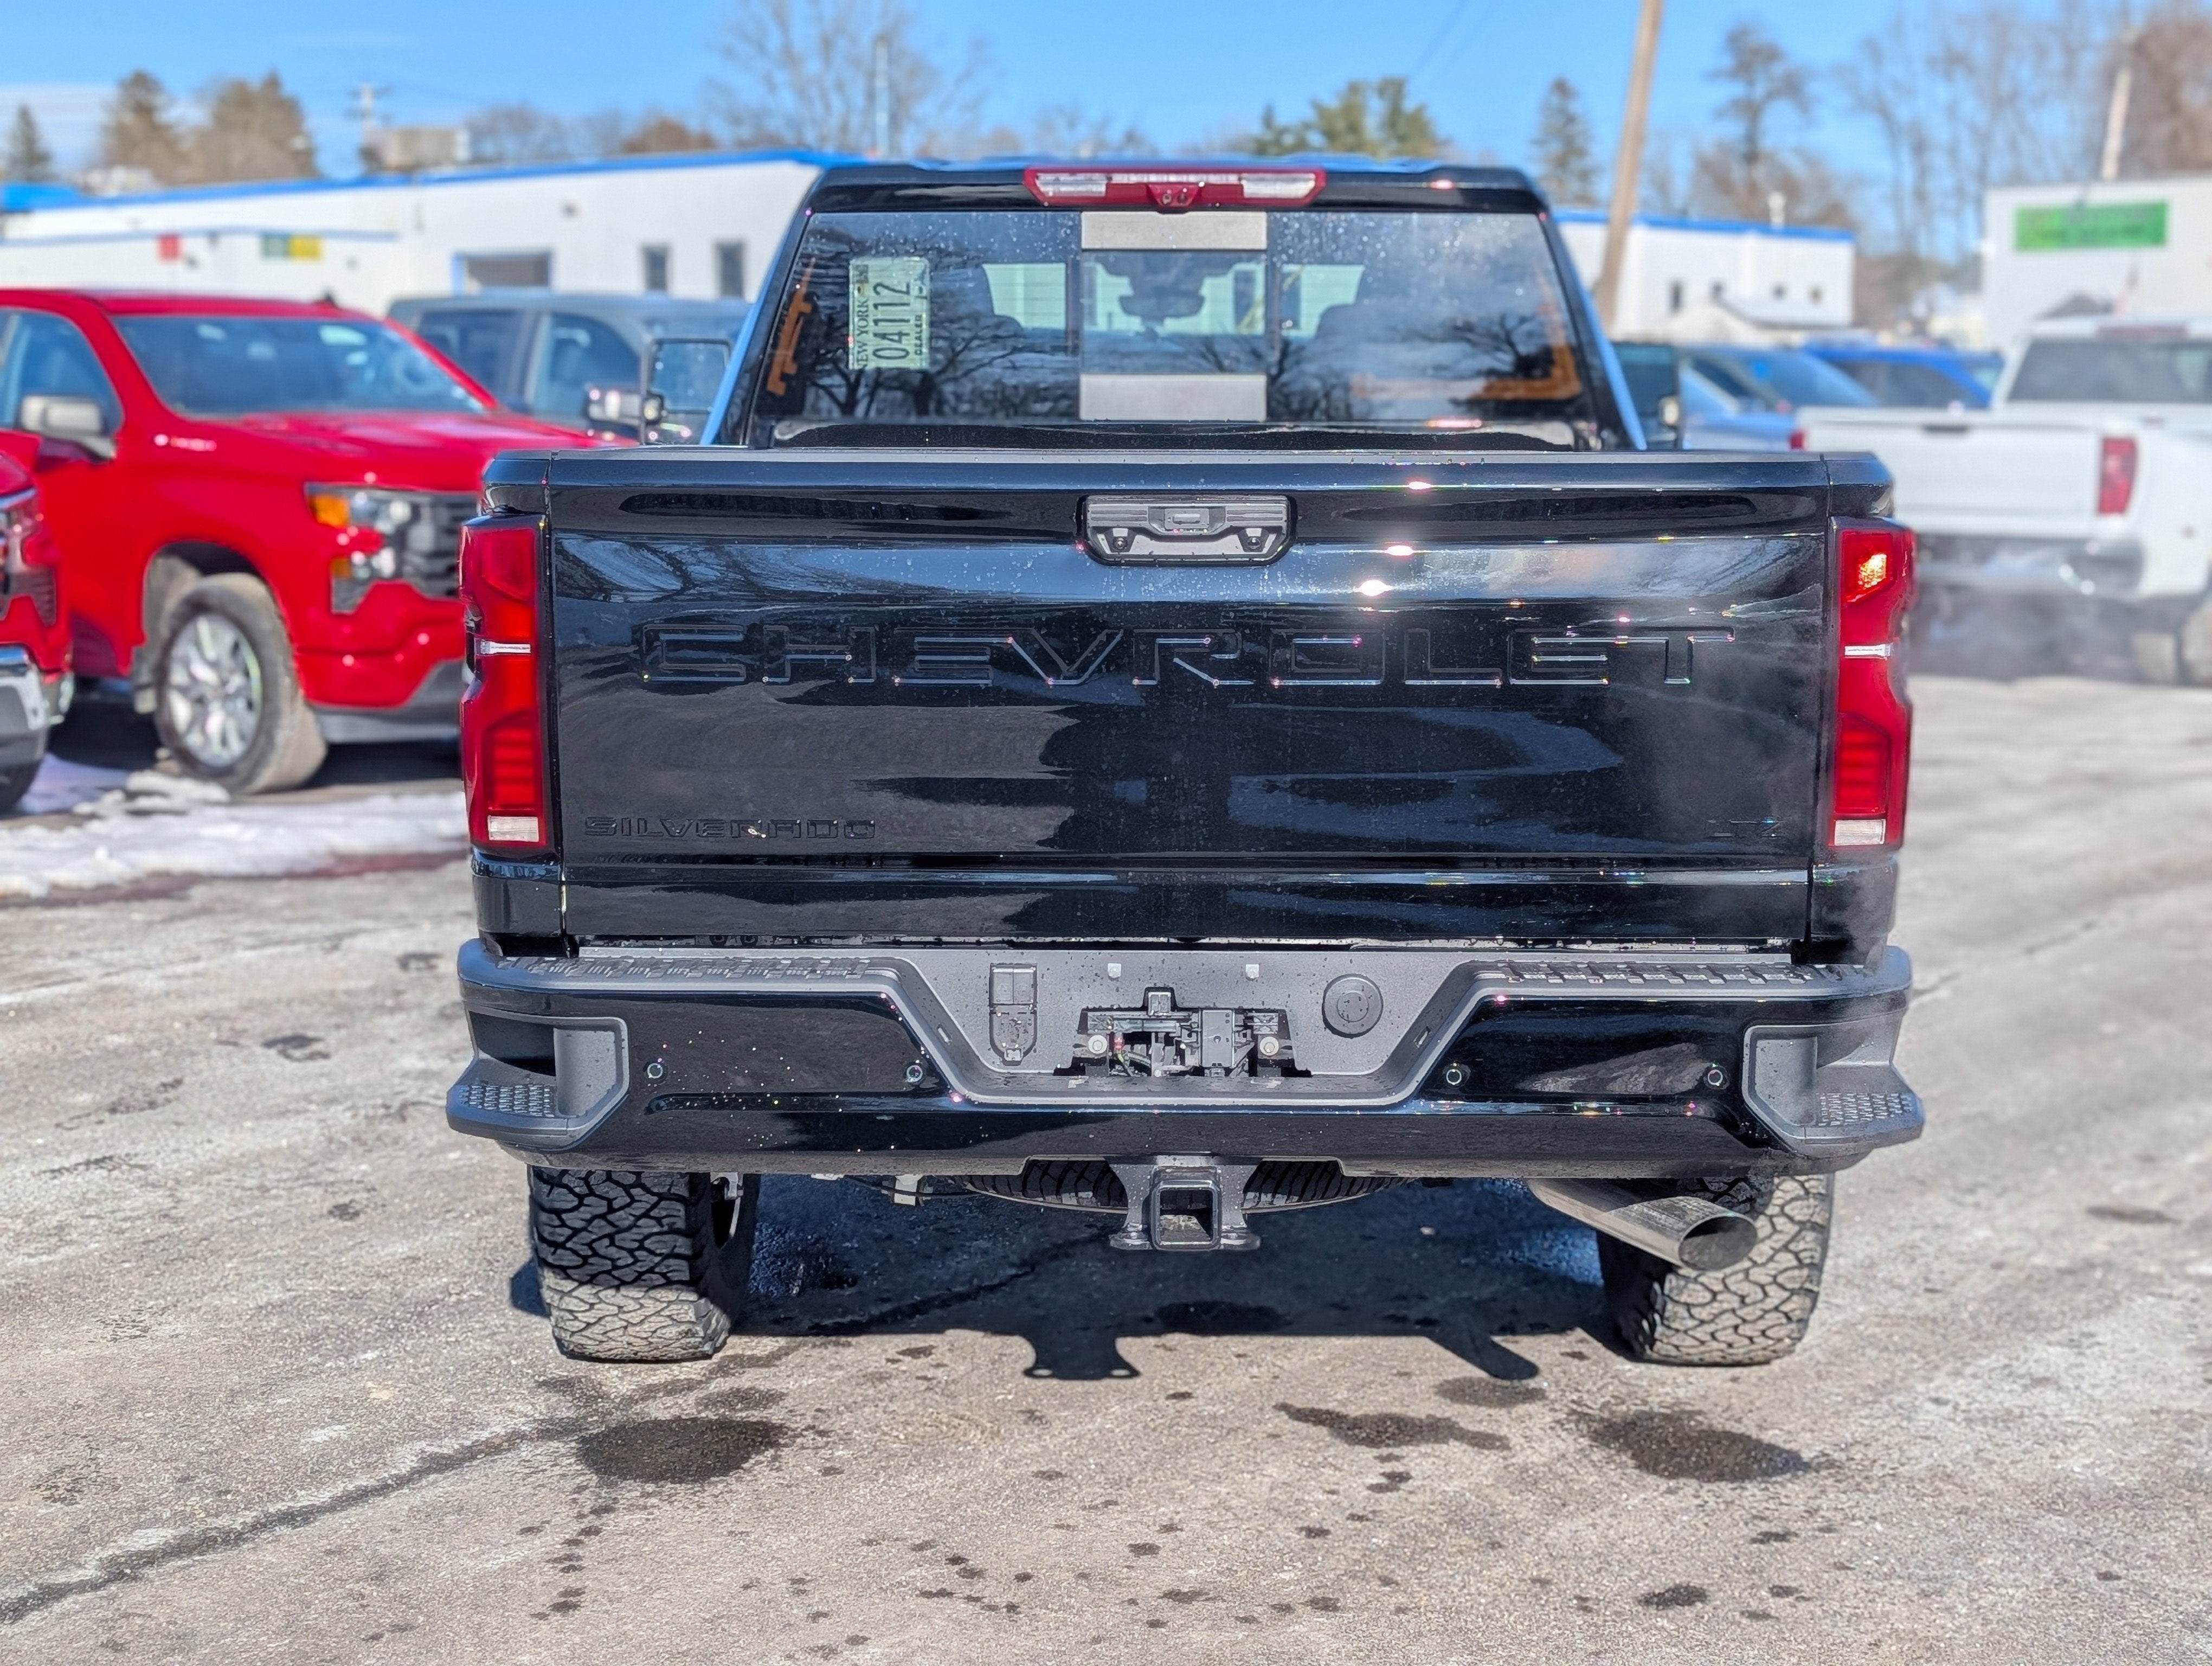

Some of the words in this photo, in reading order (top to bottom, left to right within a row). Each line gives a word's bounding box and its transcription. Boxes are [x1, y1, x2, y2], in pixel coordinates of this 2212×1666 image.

[856, 298, 869, 337] YORK
[872, 282, 911, 360] 04112
[914, 314, 923, 356] DEALER
[642, 623, 1735, 685] CHEVROLET
[584, 816, 876, 839] SILVERADO
